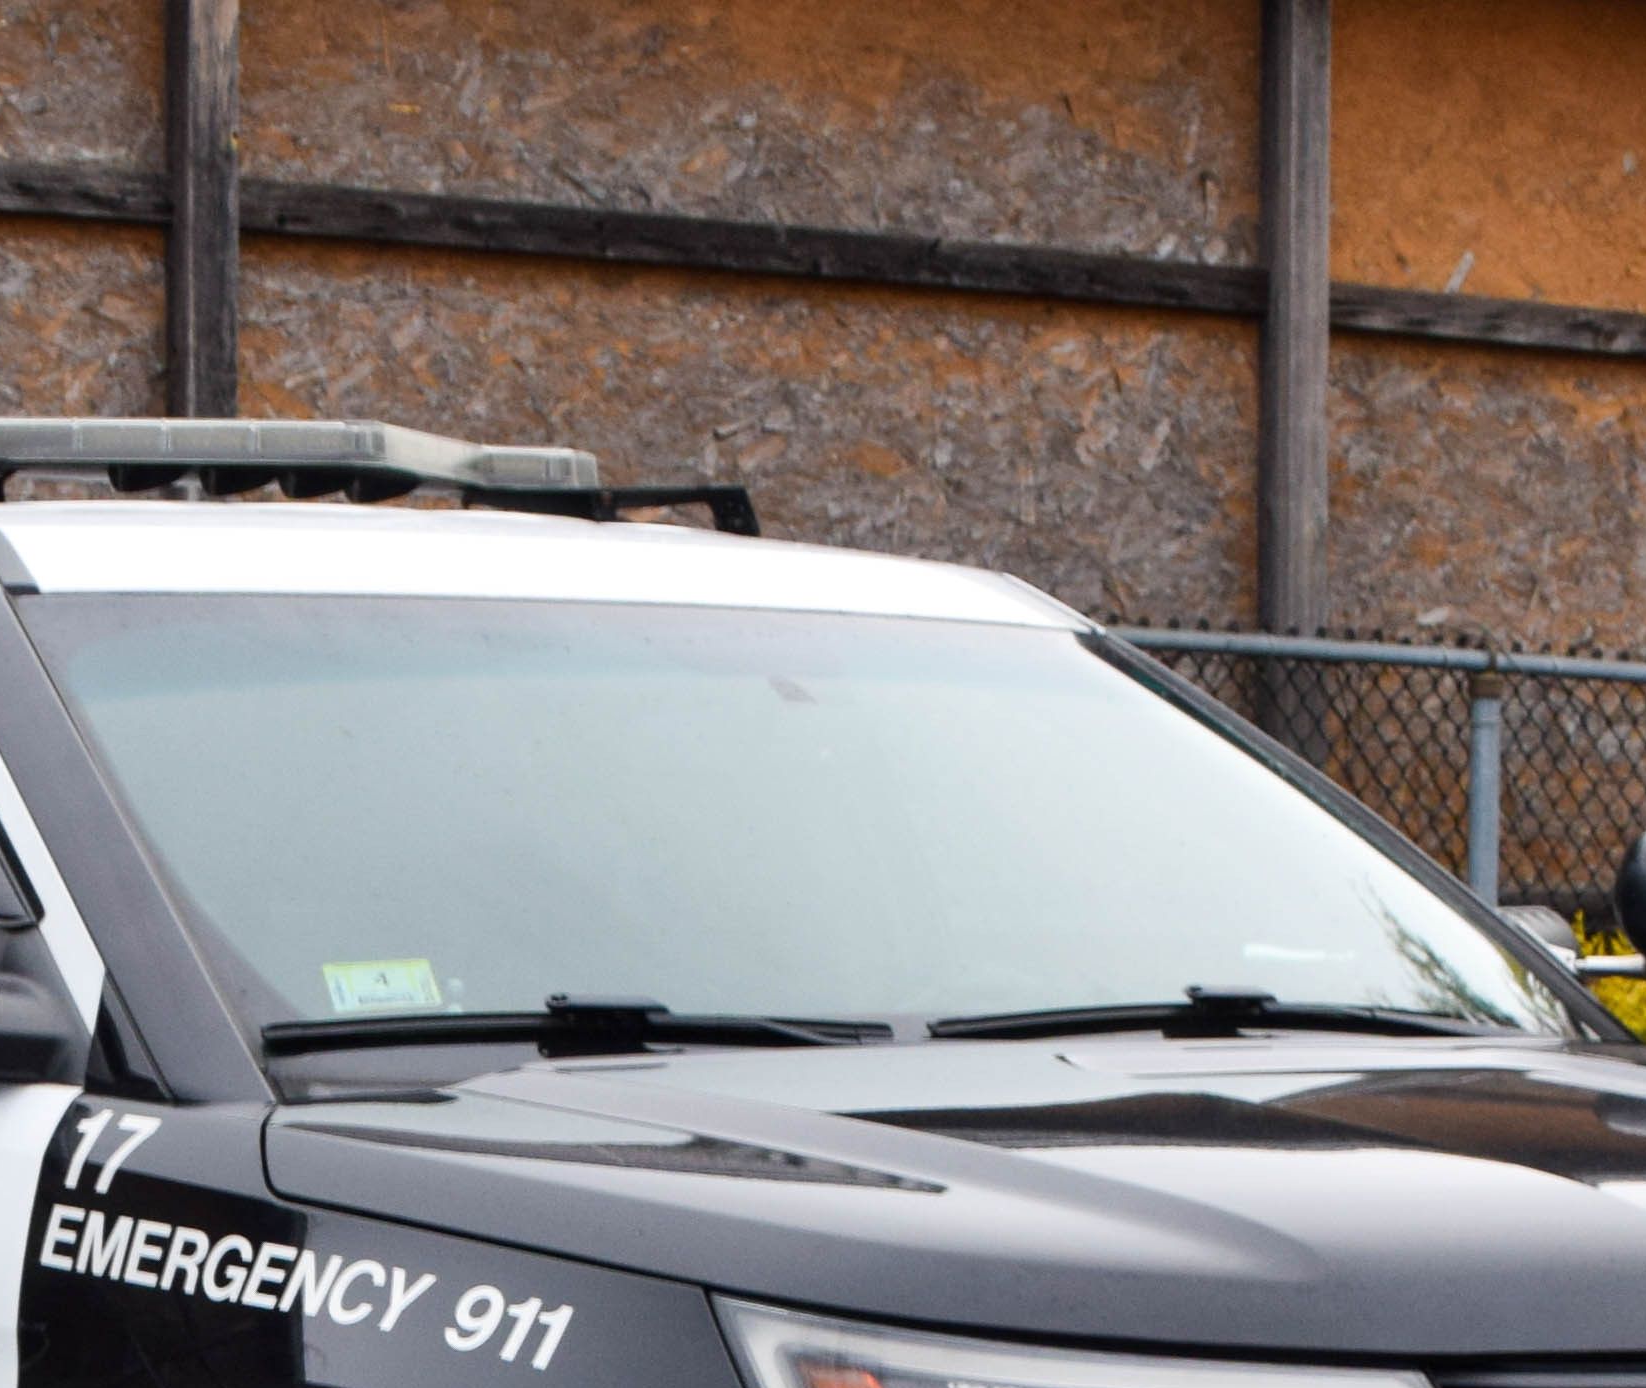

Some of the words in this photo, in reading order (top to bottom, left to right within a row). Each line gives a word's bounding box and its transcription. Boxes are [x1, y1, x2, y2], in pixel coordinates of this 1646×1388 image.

[64, 1108, 161, 1194] 17
[40, 1204, 436, 1332] EMERGENCY
[444, 1285, 574, 1371] 911
